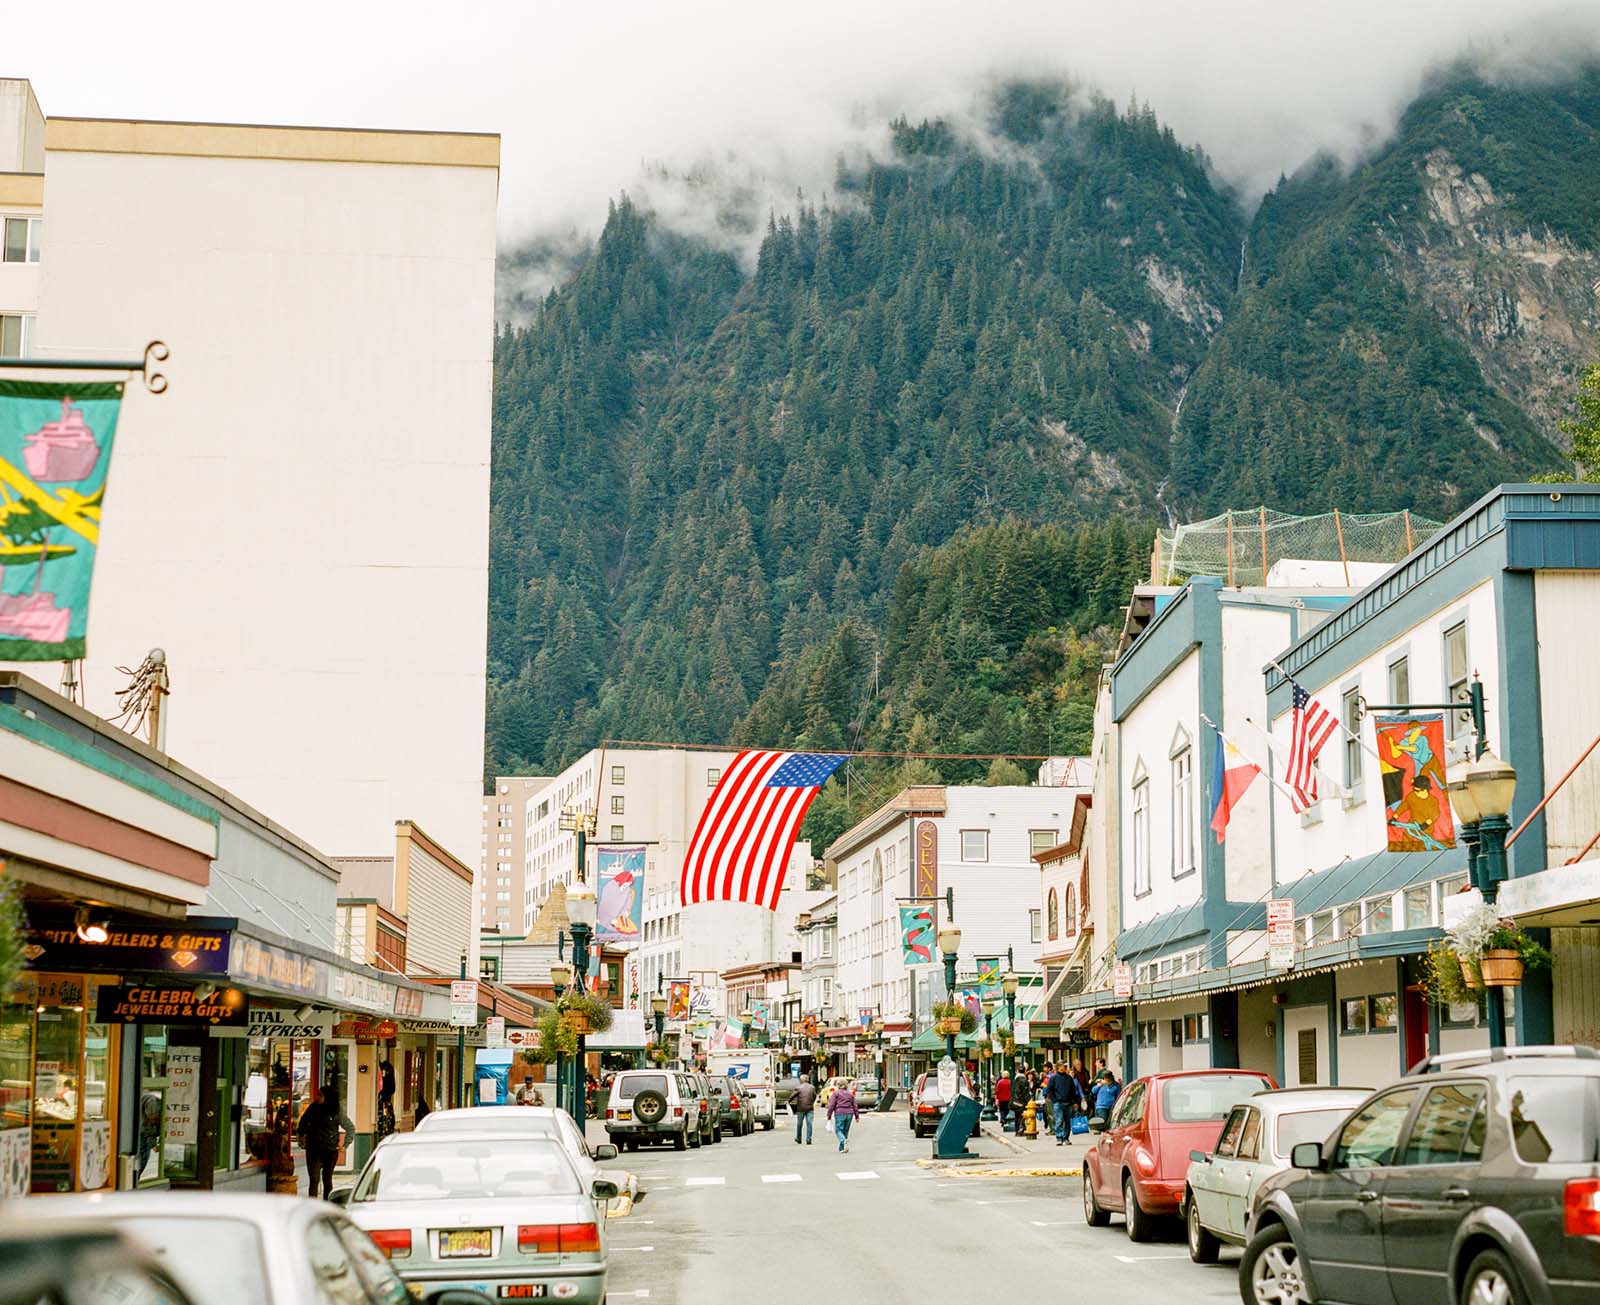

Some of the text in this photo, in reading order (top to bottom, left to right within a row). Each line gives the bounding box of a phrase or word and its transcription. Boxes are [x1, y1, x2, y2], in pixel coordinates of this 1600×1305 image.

[921, 831, 934, 897] SENA
[160, 935, 174, 948] &
[178, 935, 221, 951] GIFTS
[114, 1002, 233, 1018] JEWELERS & GIFTS
[247, 1024, 323, 1037] EXPRESS
[501, 1286, 543, 1298] EARTH
